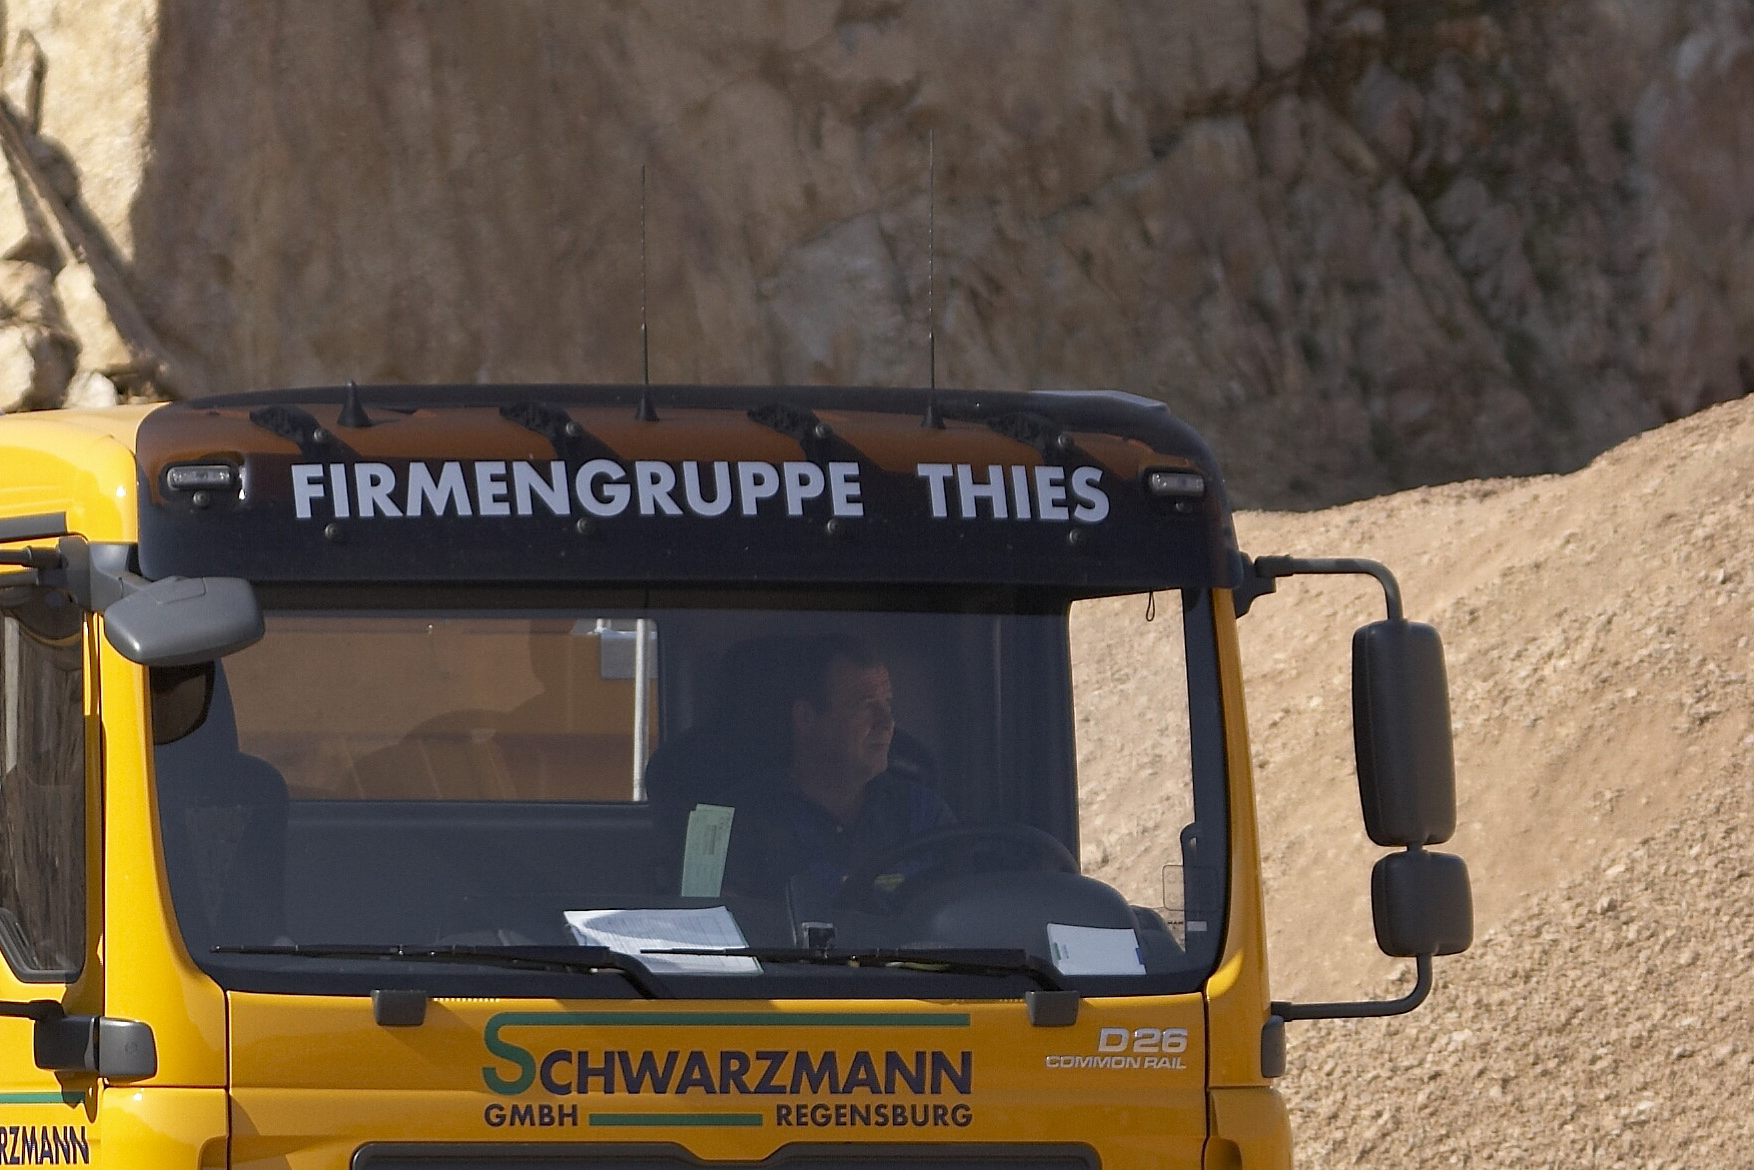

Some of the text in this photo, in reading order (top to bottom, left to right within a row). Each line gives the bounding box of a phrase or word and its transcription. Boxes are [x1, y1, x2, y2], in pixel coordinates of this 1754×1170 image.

[290, 460, 1110, 522] FIRMENGRUPPE THIES
[482, 1012, 973, 1097] SCHWARZMANN
[1046, 1056, 1187, 1069] COMMON RAIL
[484, 1103, 973, 1128] GMBH REGENSBURG
